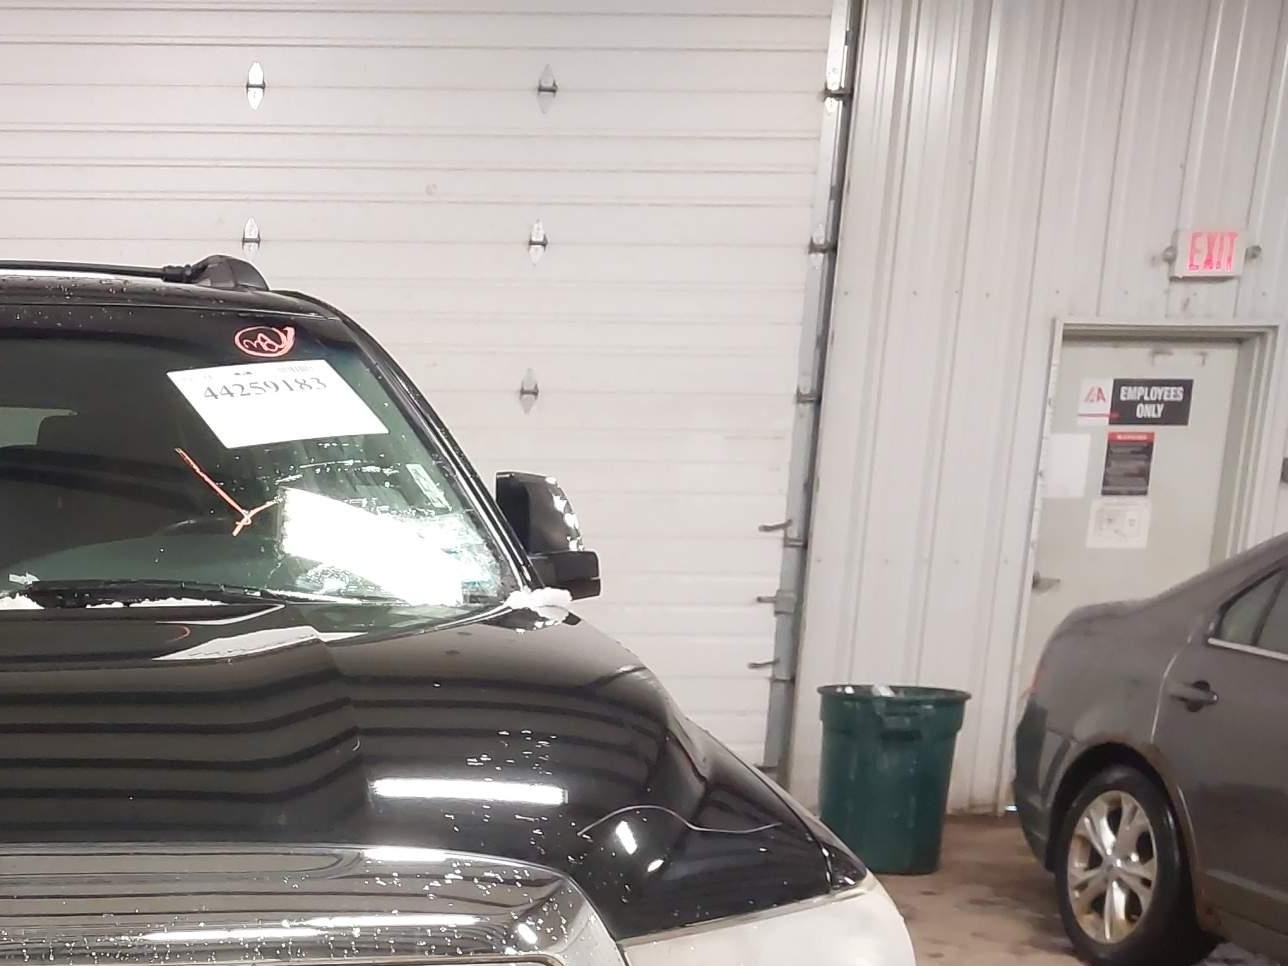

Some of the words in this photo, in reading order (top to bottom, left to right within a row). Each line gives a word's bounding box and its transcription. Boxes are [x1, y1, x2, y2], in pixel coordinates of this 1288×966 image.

[1187, 231, 1239, 272] EXIT
[204, 376, 327, 400] 44259183
[1119, 385, 1185, 401] EMPLOYEES
[1135, 403, 1165, 419] ONLY
